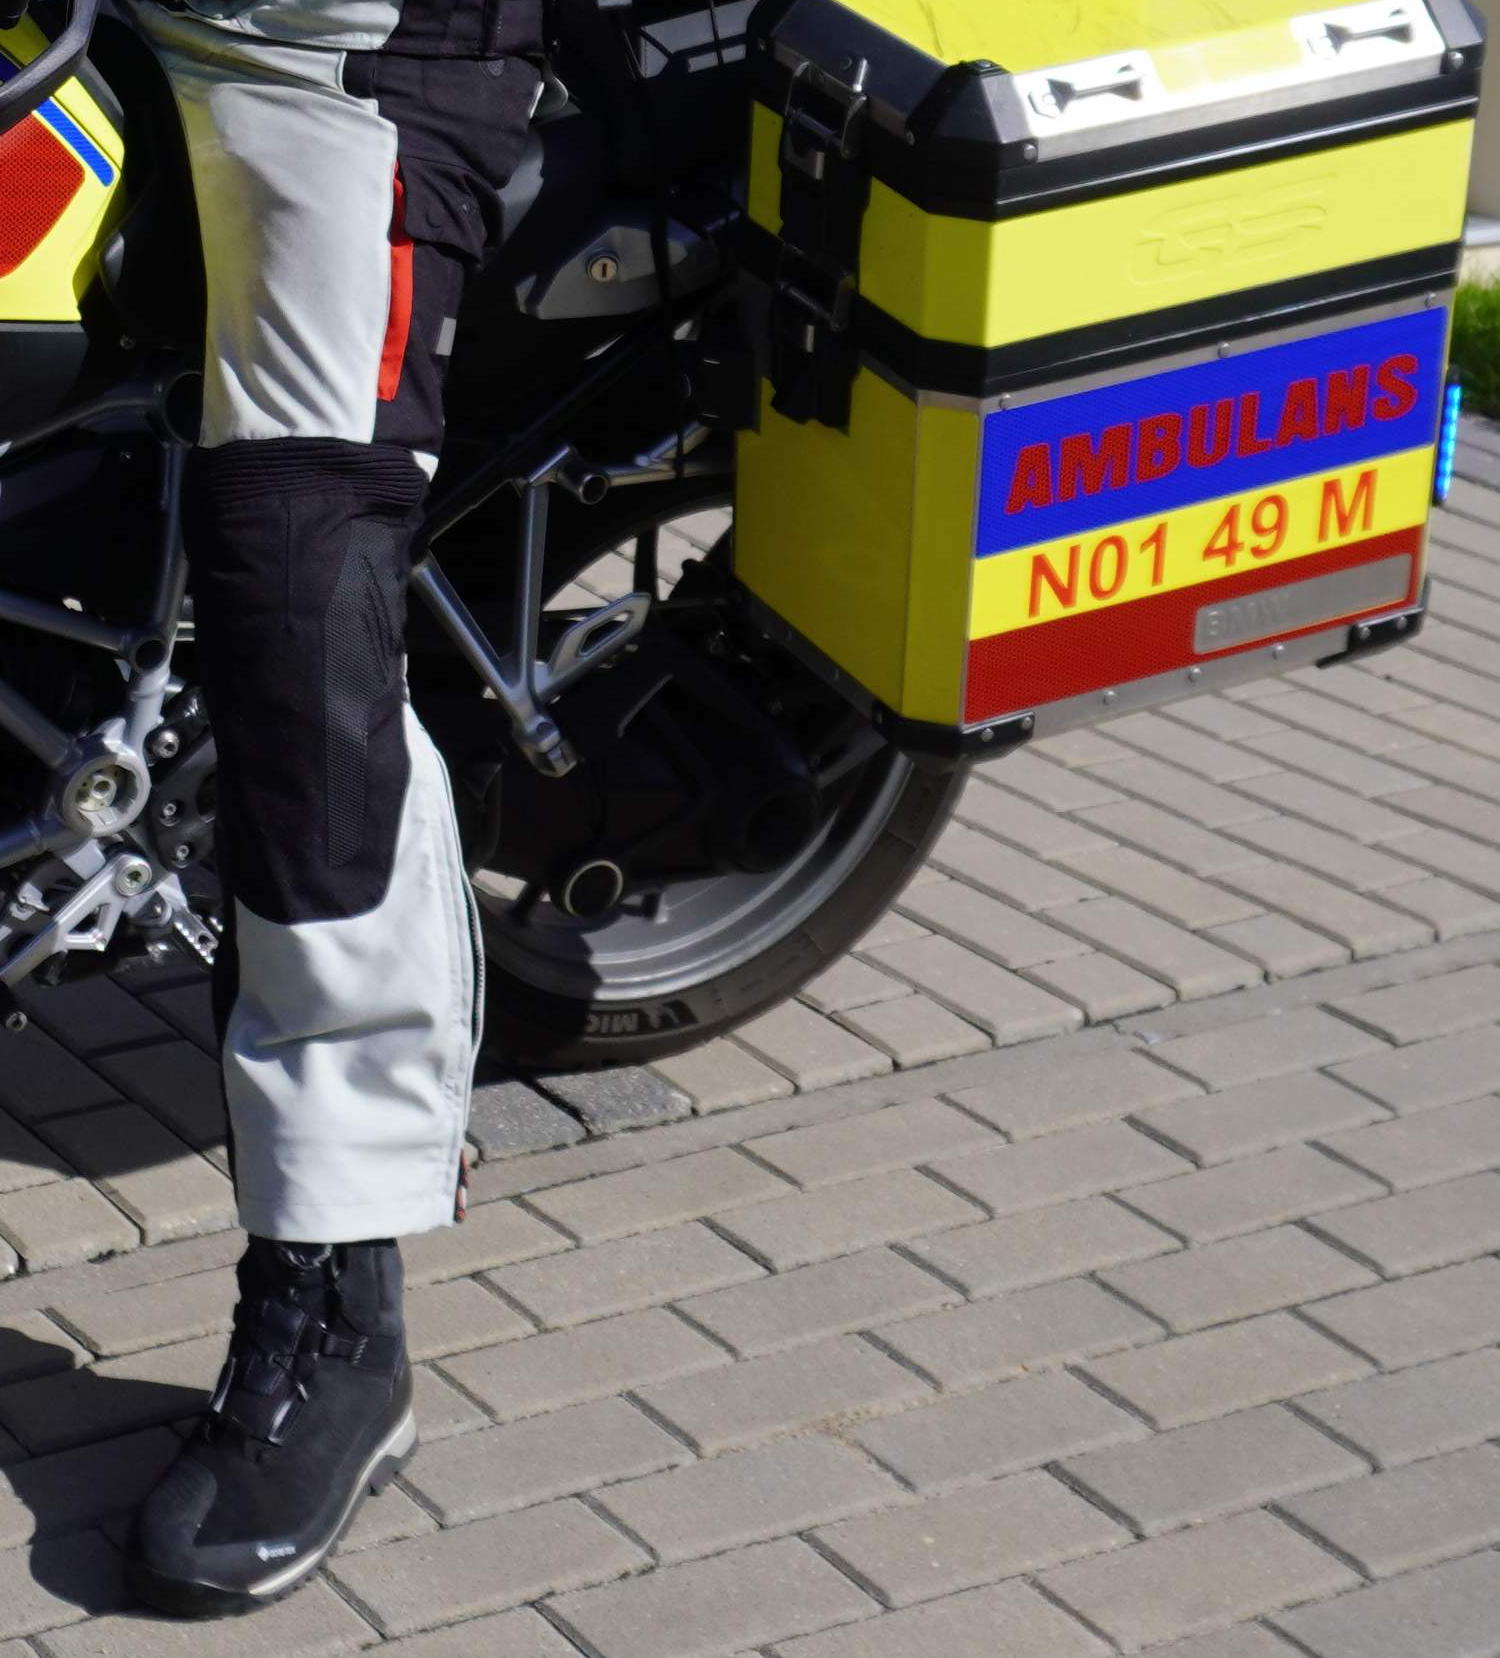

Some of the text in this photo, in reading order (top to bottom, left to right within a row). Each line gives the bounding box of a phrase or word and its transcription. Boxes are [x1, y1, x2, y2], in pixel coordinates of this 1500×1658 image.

[1004, 354, 1419, 515] AMBULANS
[1201, 494, 1290, 569] 49
[1318, 468, 1378, 544] M
